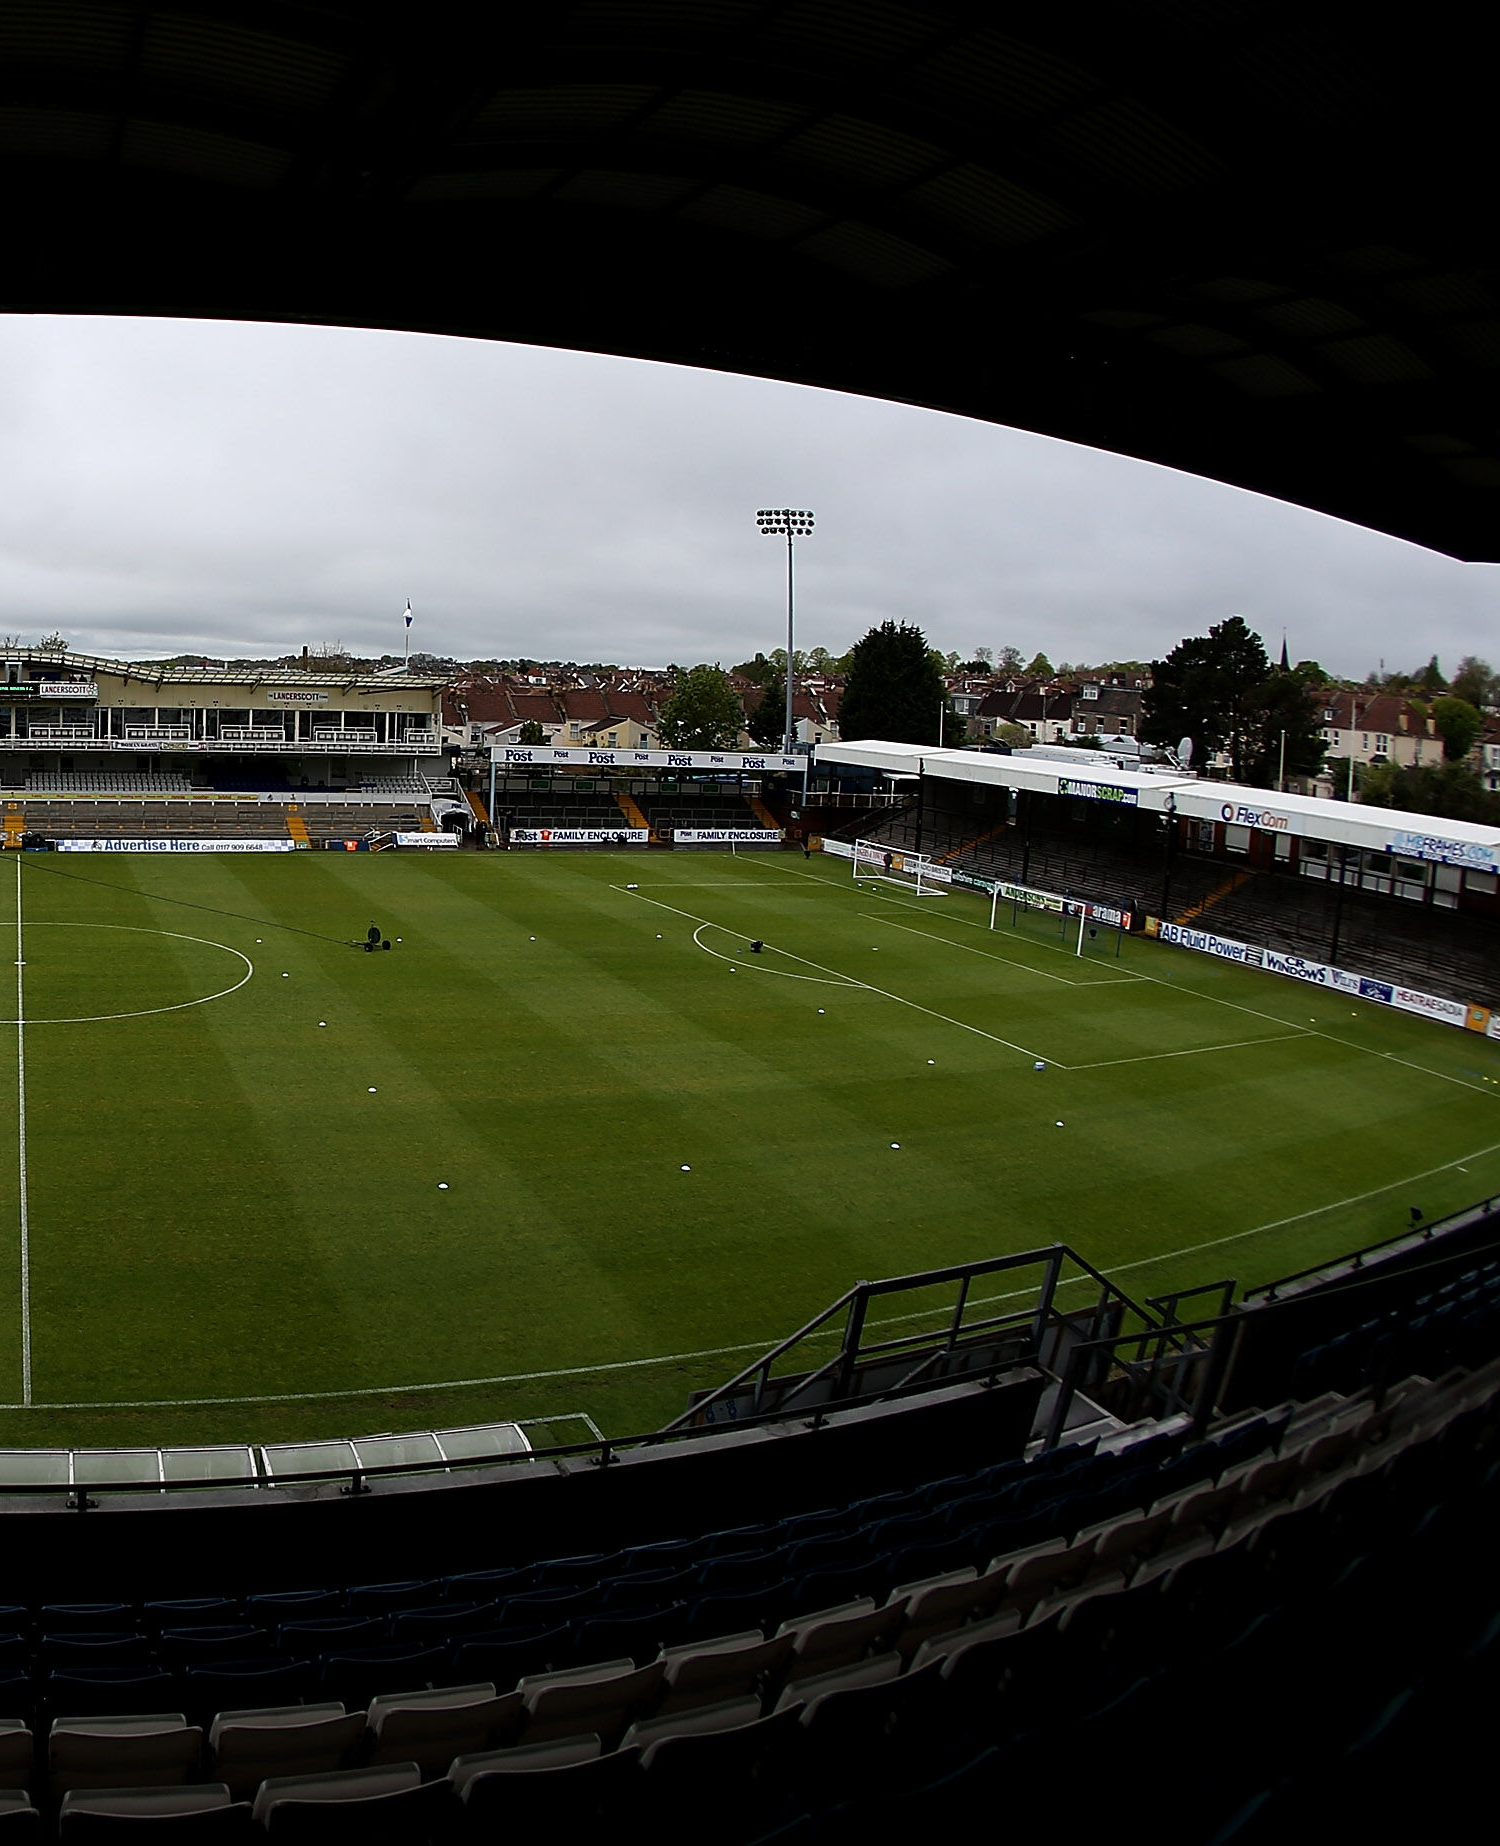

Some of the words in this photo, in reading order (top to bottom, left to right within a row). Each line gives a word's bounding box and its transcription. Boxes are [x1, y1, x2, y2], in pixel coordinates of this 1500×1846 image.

[41, 686, 86, 694] LANCERSCOTT
[273, 692, 319, 701] LANCERSCOTT
[505, 749, 533, 762] Post
[553, 750, 569, 758] Post
[589, 751, 615, 764] Post
[634, 753, 649, 761] Post
[710, 755, 724, 763] Post
[668, 754, 692, 767] Post
[742, 757, 766, 769] Post
[782, 758, 796, 766] Post
[1068, 781, 1137, 804] MANORSCRAP.com
[1236, 806, 1288, 830] FlexCom
[423, 837, 457, 845] Computers
[553, 831, 586, 840] FAMILY
[587, 831, 643, 840] ENCLOSURE
[697, 831, 727, 840] FAMILY
[728, 831, 778, 840] ENCLOSURE
[104, 839, 168, 851] Advertise
[170, 840, 200, 851] Here
[1162, 925, 1179, 942] AB
[1180, 929, 1207, 949] Fluid
[1208, 936, 1245, 960] Power
[1267, 952, 1327, 983] WINDOWS
[1285, 956, 1305, 968] CR
